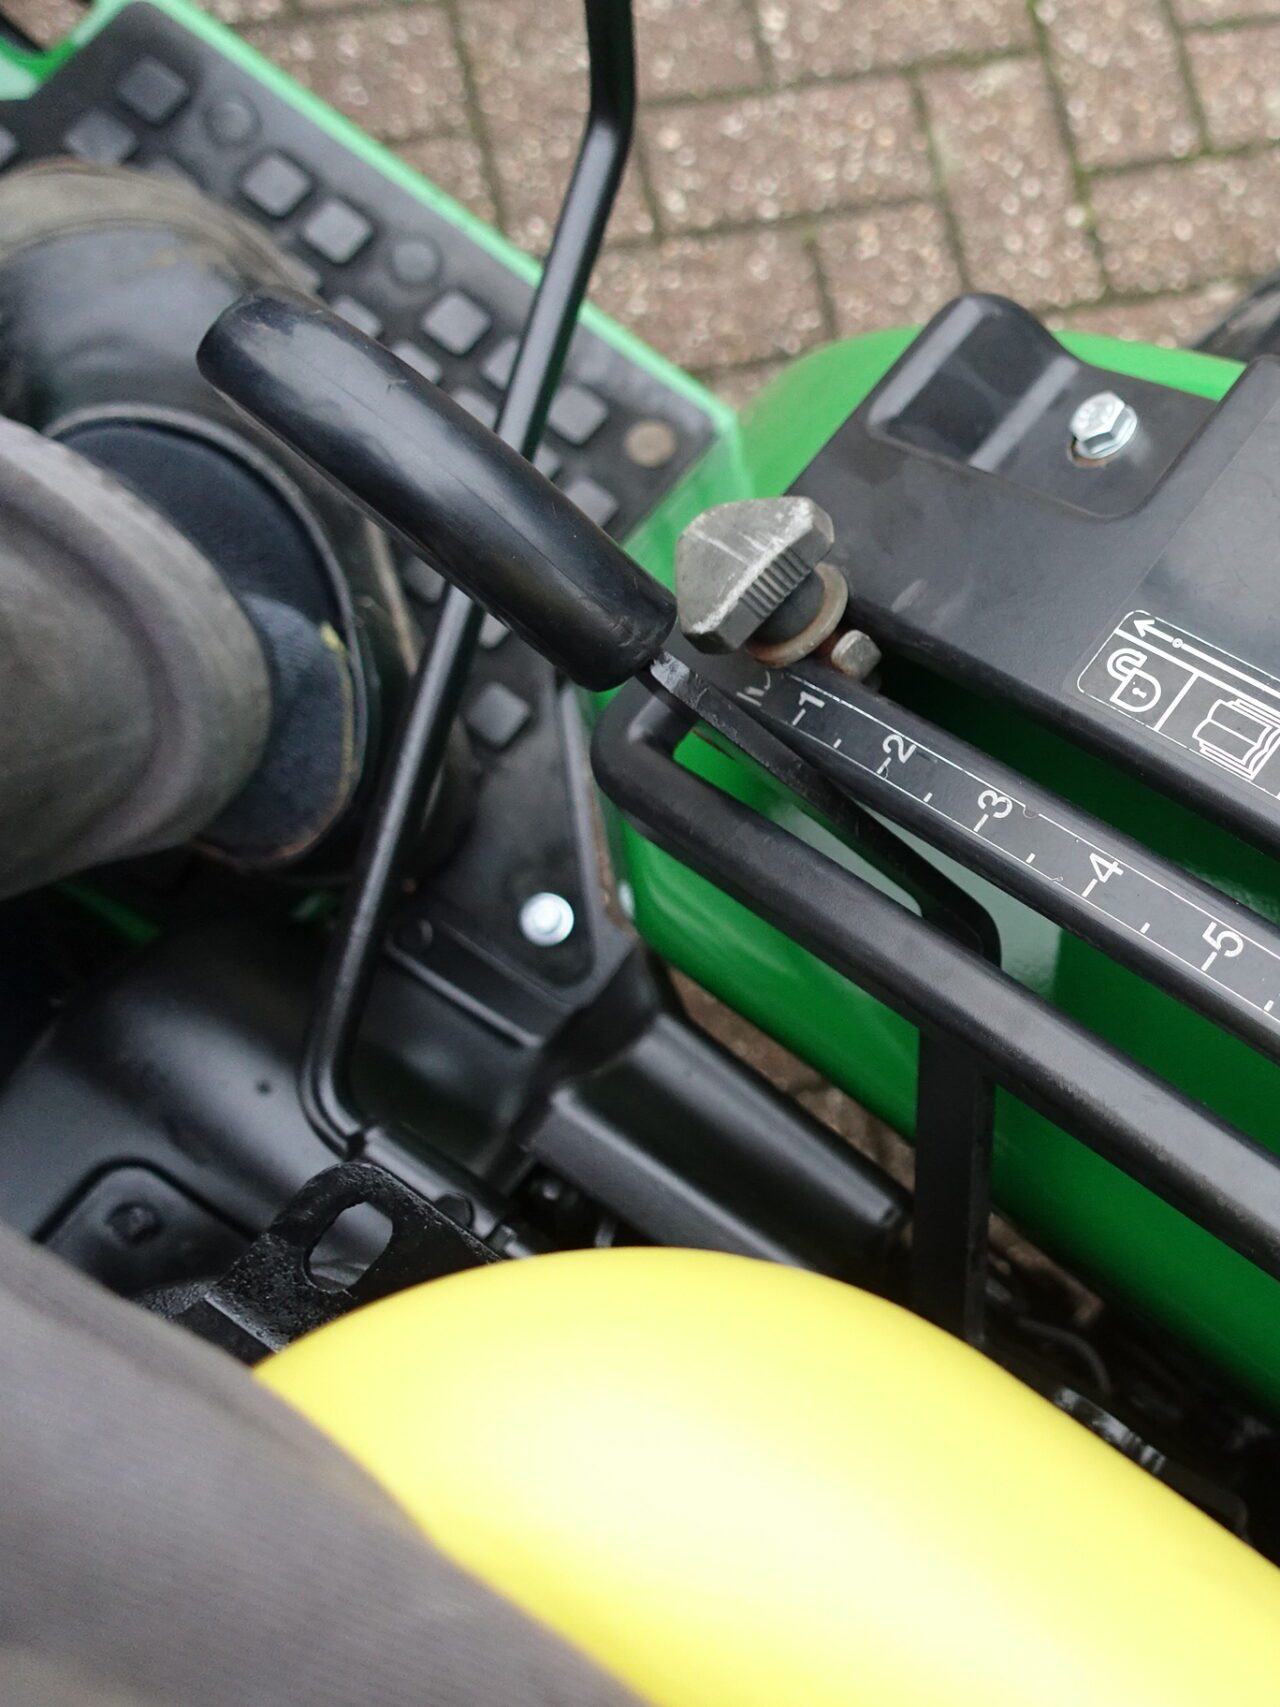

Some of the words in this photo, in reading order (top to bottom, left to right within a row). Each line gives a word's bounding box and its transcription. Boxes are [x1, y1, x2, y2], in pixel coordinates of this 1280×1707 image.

[798, 690, 826, 709] 1
[882, 734, 917, 764] 2
[978, 790, 1012, 819] 3
[1088, 852, 1124, 884] 4
[1202, 922, 1244, 959] 5
